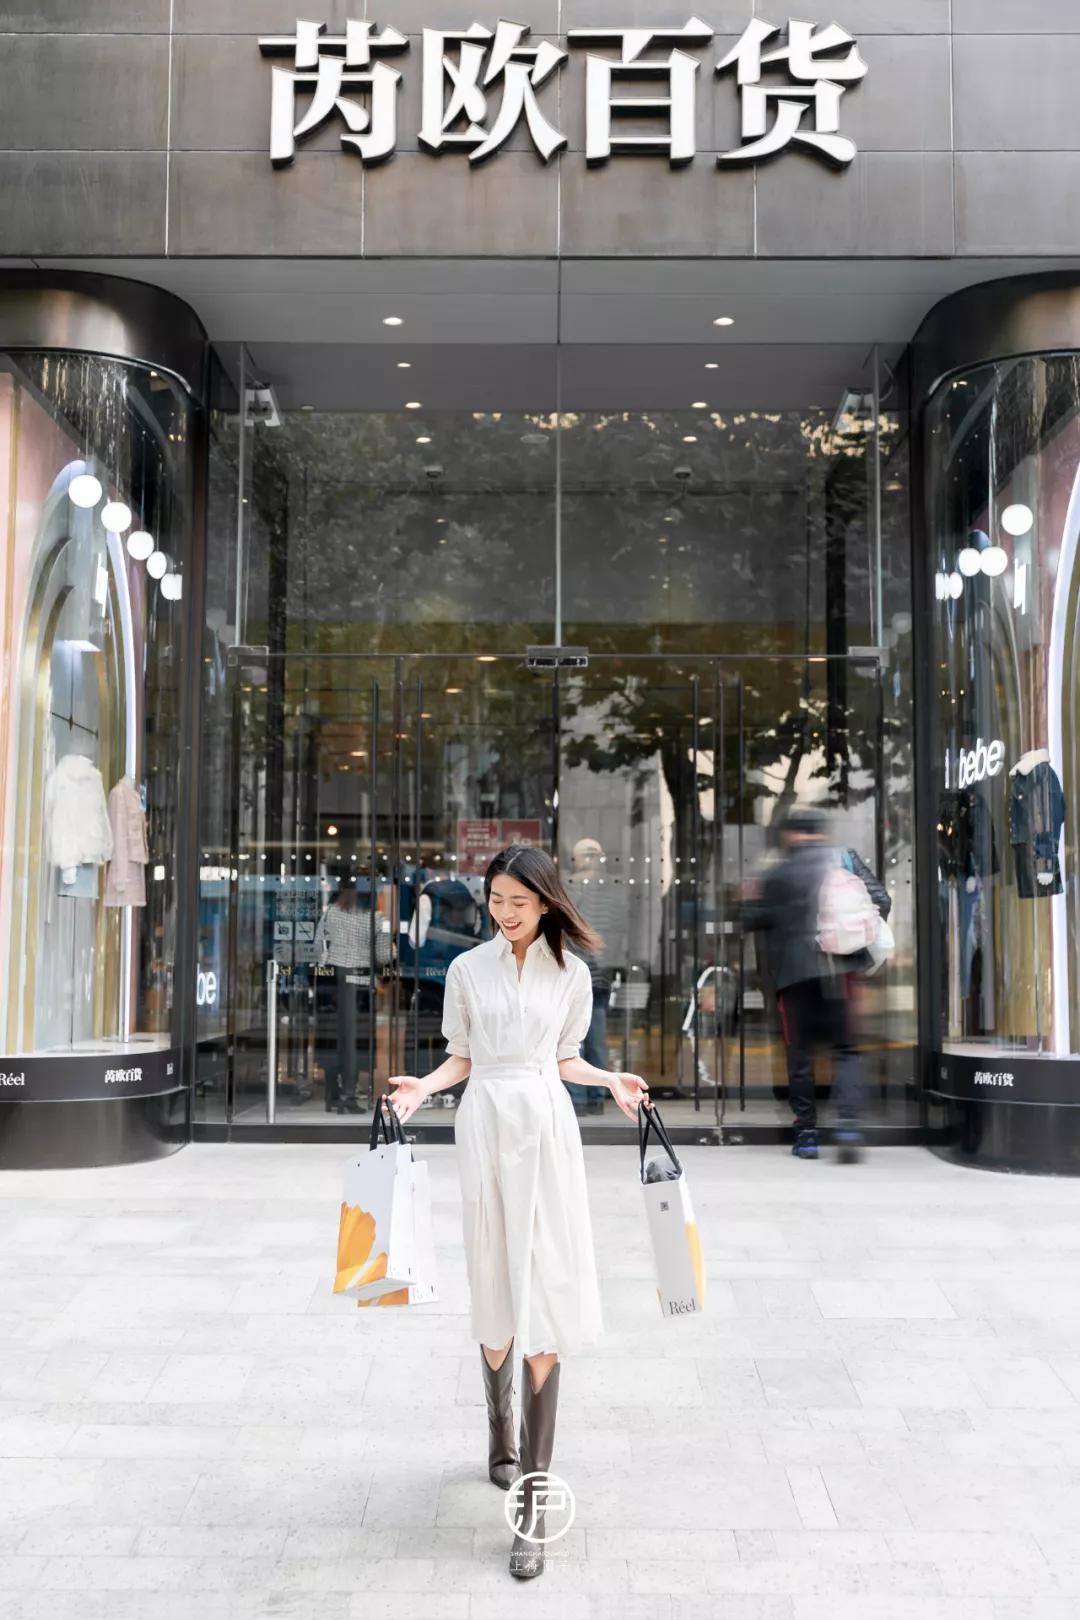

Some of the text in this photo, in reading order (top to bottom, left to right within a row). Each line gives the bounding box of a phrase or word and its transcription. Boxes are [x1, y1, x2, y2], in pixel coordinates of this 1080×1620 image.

[258, 17, 869, 175] 芮欧百货
[958, 737, 1006, 789] bebe
[0, 1072, 25, 1086] Réel
[104, 1067, 143, 1084] 芮欧百货
[973, 1070, 1014, 1087] 芮欧百货
[668, 1298, 697, 1316] Réel
